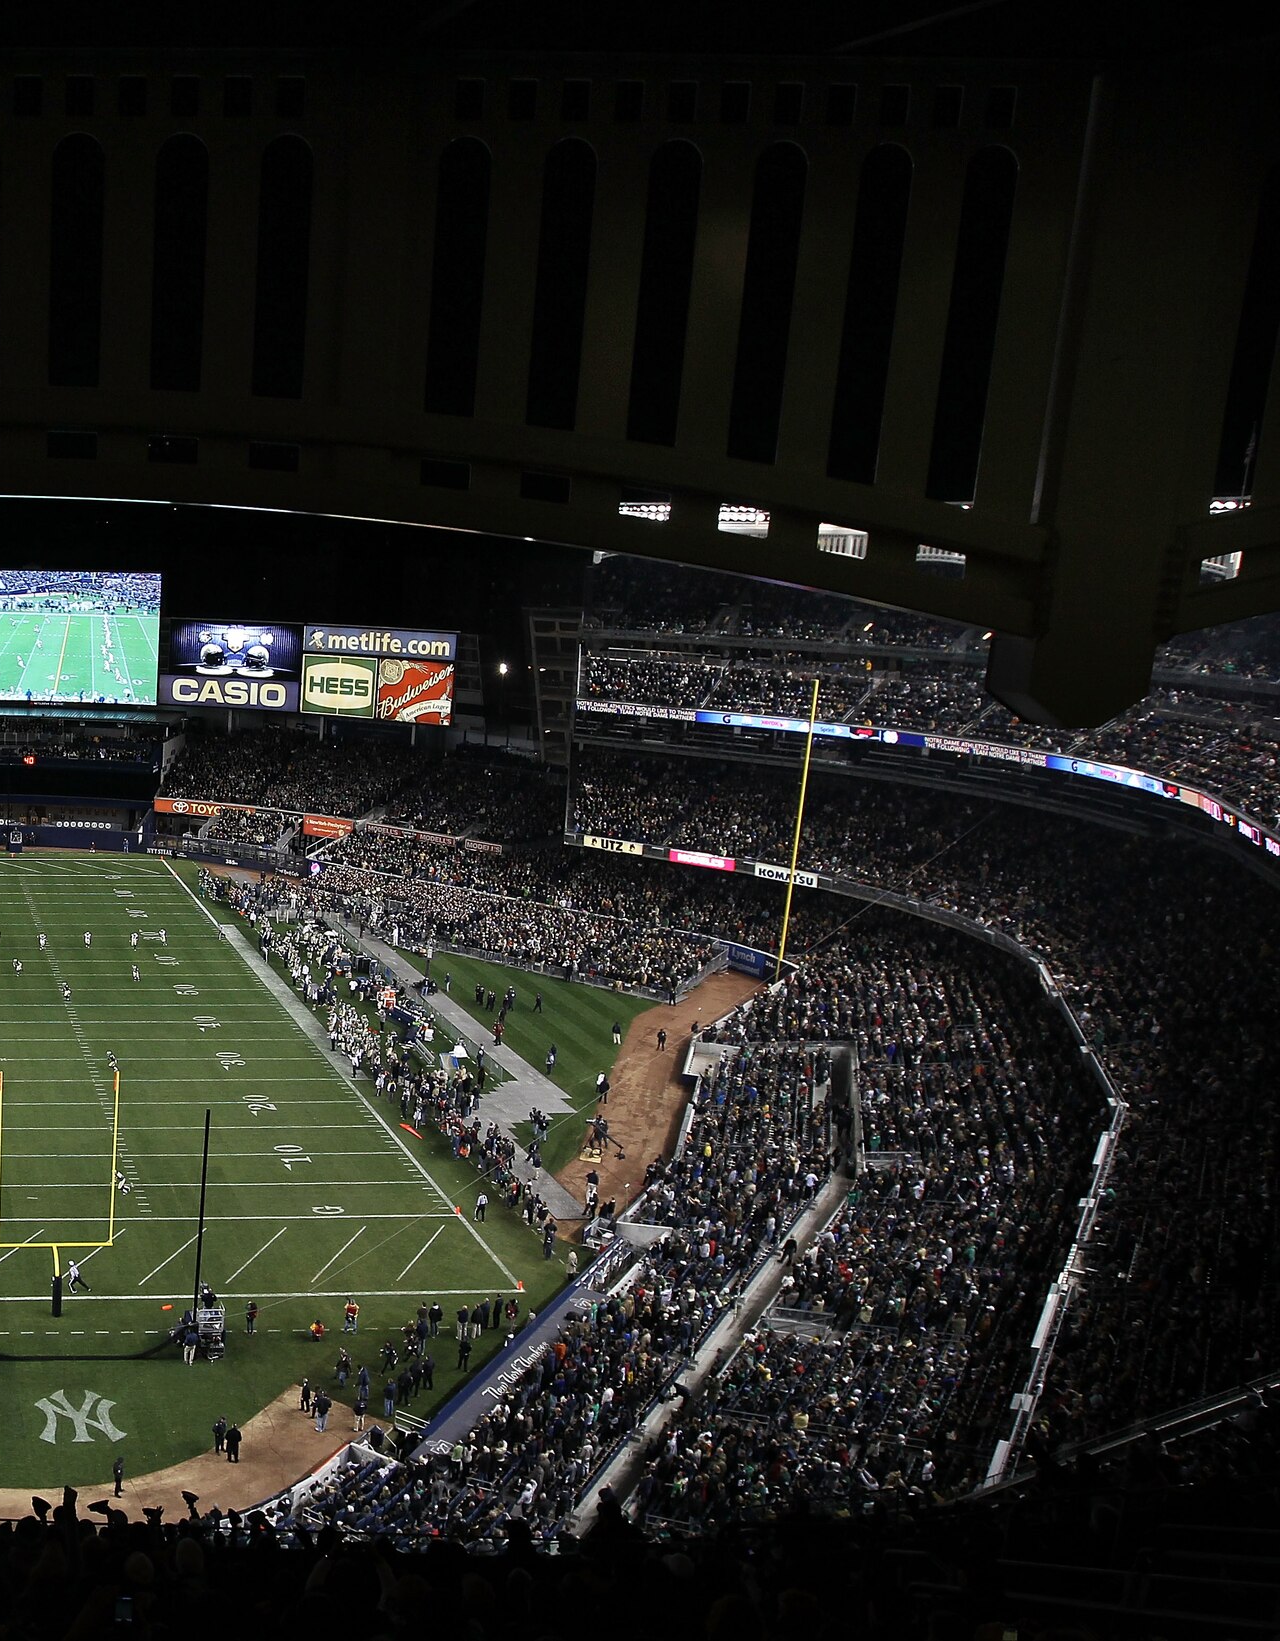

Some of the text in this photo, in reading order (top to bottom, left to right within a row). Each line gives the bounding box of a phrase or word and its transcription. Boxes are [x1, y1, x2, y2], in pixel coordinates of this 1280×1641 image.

[327, 631, 450, 657] metlife.com
[172, 678, 287, 708] CASIO
[309, 676, 369, 697] HESS
[378, 663, 455, 719] Budweiser
[405, 704, 432, 718] American
[587, 706, 617, 714] FOLLOWING
[669, 713, 696, 721] PARTNERS
[609, 703, 635, 711] ATHLETICS
[937, 743, 970, 753] FOLLOWING
[973, 748, 988, 756] TEAM
[1021, 757, 1046, 768] PARTNERS
[961, 741, 989, 751] ATHLETICS
[1009, 748, 1020, 756] LIKE
[23, 757, 34, 765] 40
[600, 838, 623, 852] UTZ
[757, 867, 814, 887] KOMATSU
[172, 983, 199, 996] 50
[192, 1015, 221, 1030] 40
[215, 1051, 246, 1067] 30
[241, 1094, 277, 1112] 20
[273, 1144, 312, 1166] 10
[481, 1341, 551, 1400] New York Yankees
[33, 1388, 128, 1445] NY
